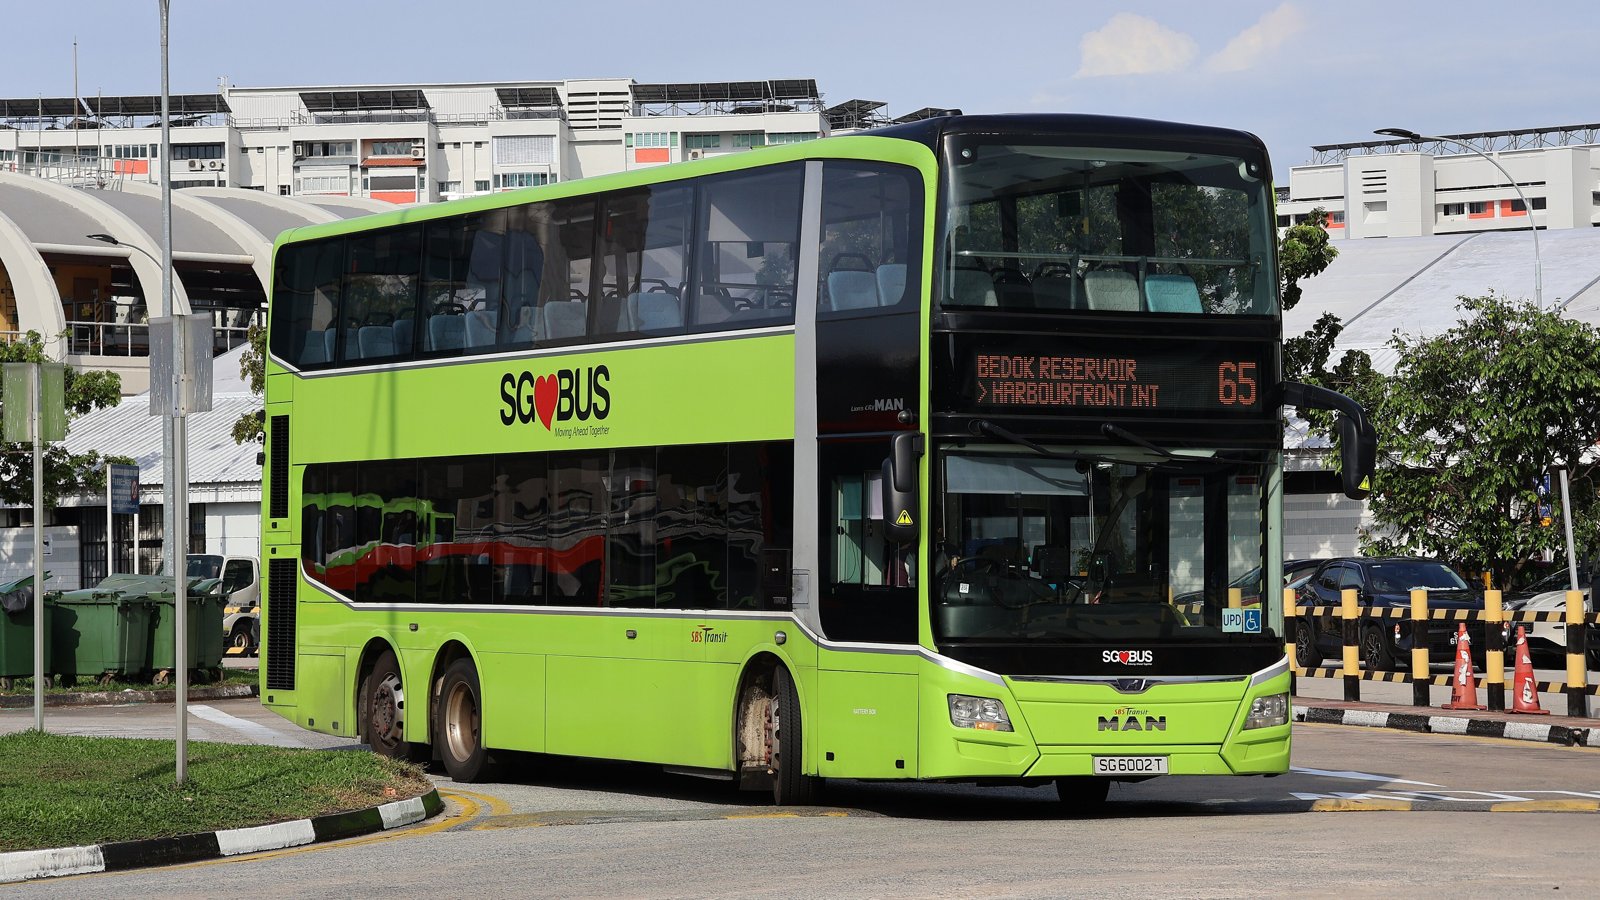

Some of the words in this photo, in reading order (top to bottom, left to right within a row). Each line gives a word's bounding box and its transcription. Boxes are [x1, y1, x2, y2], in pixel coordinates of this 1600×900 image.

[977, 355, 1034, 379] BEDOK
[1039, 357, 1137, 381] RESERVOIR
[1218, 361, 1257, 405] 65
[992, 382, 1127, 406] HARBOURFRONT
[1131, 384, 1160, 407] INT
[874, 398, 904, 412] MAN
[554, 427, 572, 439] Moving
[572, 426, 588, 437] Ahead
[589, 425, 610, 438] Together
[1223, 614, 1241, 626] UPD
[691, 631, 703, 643] SBS
[702, 627, 728, 645] Transit
[1125, 707, 1148, 715] Transit
[1098, 716, 1166, 731] MAN
[1099, 758, 1163, 772] SG6002T
